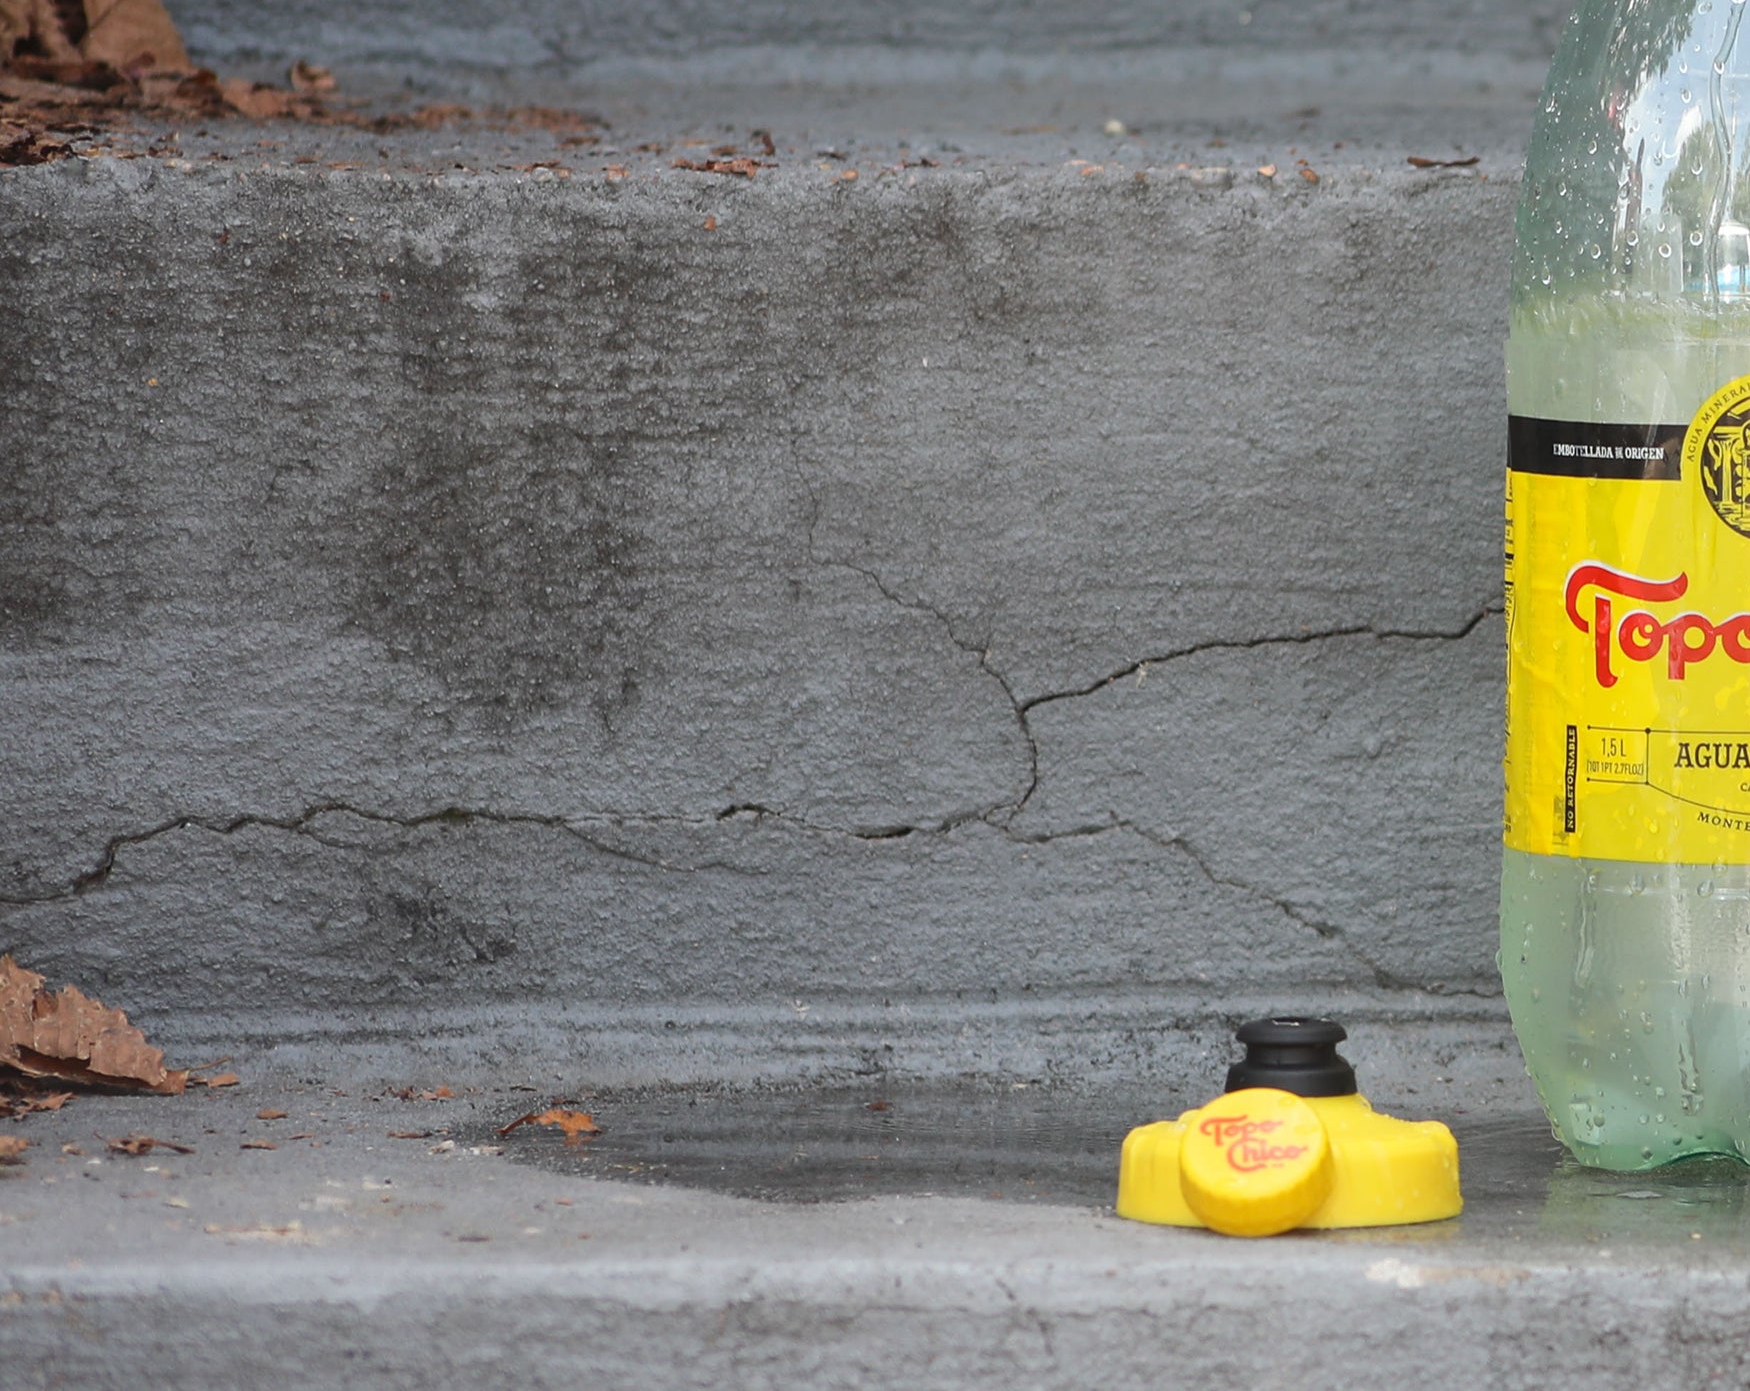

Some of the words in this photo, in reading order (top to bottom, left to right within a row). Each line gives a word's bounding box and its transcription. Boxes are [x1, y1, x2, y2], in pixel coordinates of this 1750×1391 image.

[1552, 443, 1613, 459] EMBOTELLADA
[1624, 446, 1665, 460] ORIGEN
[1686, 427, 1703, 462] AGUA
[1620, 739, 1627, 757] L
[1567, 728, 1577, 807] RETORNABLE
[1567, 810, 1575, 828] NO
[1199, 1114, 1284, 1146] Topo
[1226, 1137, 1308, 1172] Chico
